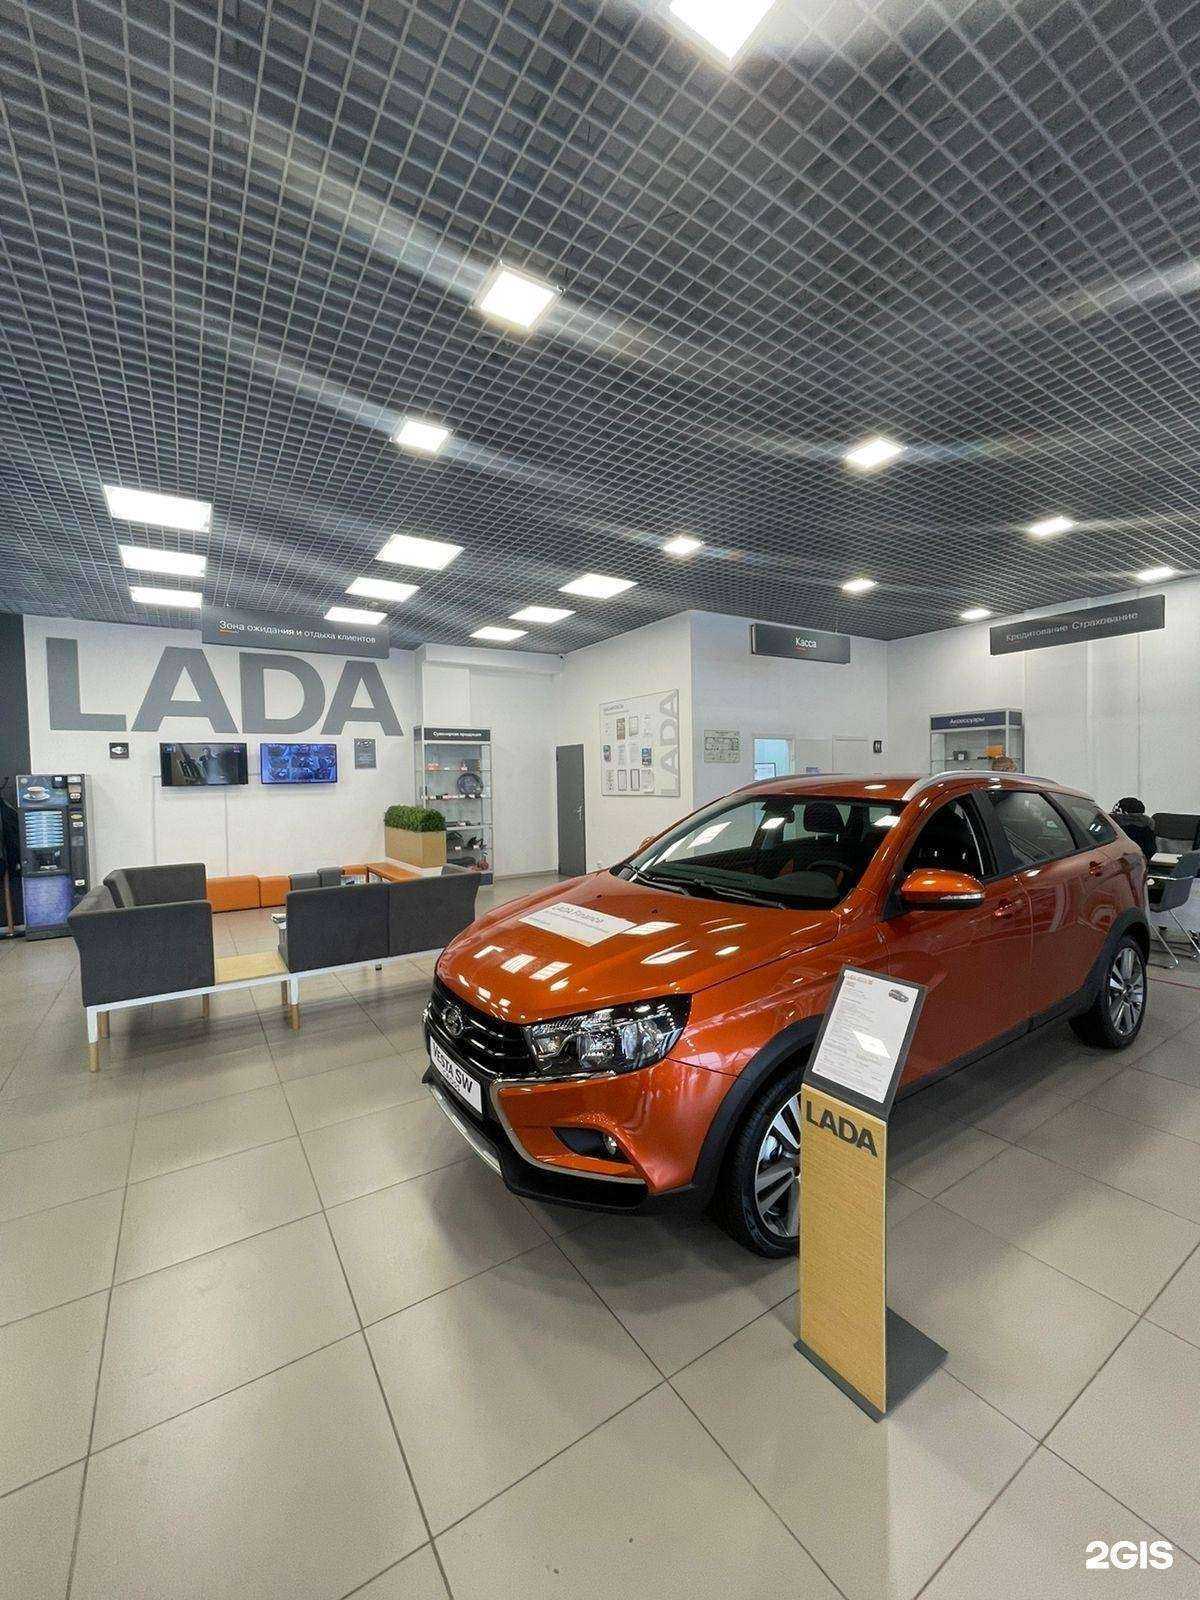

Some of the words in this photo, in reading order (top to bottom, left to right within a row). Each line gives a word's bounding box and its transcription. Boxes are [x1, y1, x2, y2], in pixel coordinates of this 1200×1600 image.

[219, 620, 245, 632] Зона
[247, 624, 294, 636] ожидания
[304, 630, 337, 641] отдыха
[337, 633, 376, 644] клиентов
[1072, 612, 1138, 631] Страхование
[795, 637, 817, 648] Касса
[45, 637, 404, 736] LADA
[660, 690, 679, 795] LADA
[455, 1069, 473, 1093] SW
[806, 1100, 877, 1157] LADA
